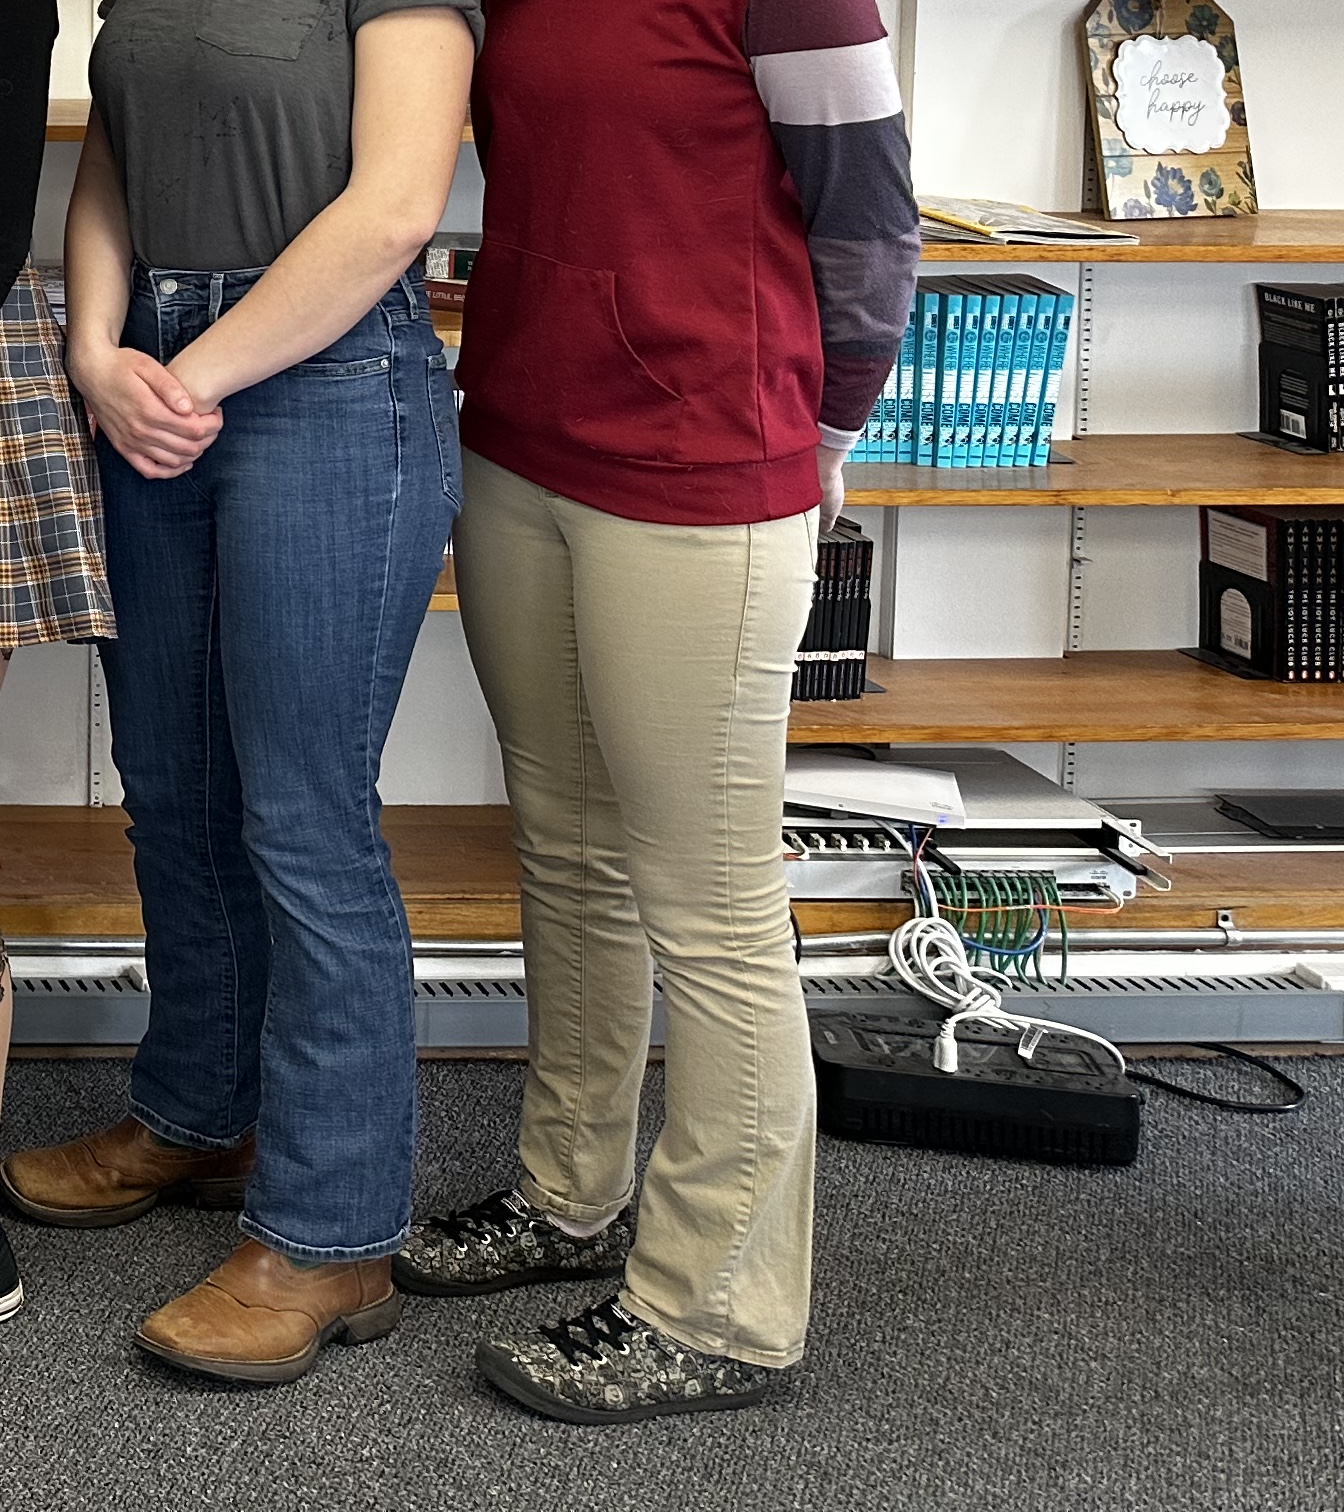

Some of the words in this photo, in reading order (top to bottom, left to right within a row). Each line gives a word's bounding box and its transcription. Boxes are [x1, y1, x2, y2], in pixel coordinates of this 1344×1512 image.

[1140, 60, 1199, 92] choose
[1147, 89, 1206, 127] happy
[1264, 292, 1286, 306] BLACK
[1287, 298, 1303, 310] LIKE
[1304, 302, 1316, 313] ME
[921, 402, 934, 426] COME
[941, 404, 953, 428] COME
[989, 403, 1003, 427] COME
[1041, 403, 1055, 426] COME
